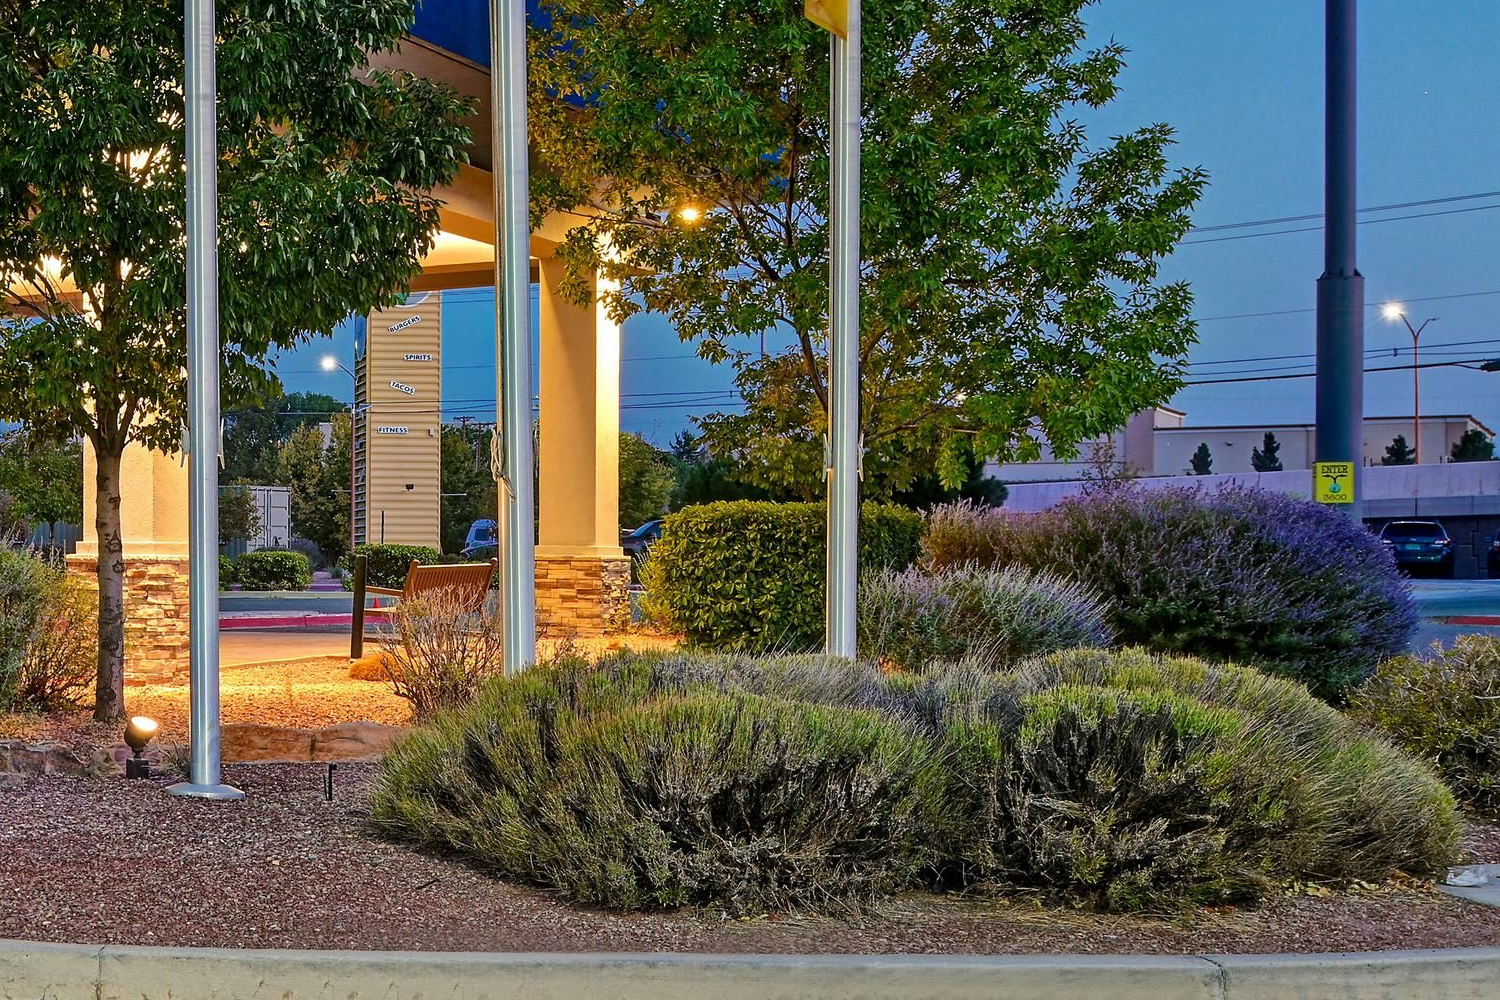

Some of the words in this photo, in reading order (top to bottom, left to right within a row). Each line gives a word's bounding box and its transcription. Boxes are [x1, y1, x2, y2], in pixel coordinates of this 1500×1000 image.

[389, 315, 421, 333] BURGERS
[391, 381, 415, 394] TACOS
[1321, 464, 1348, 474] ENTER
